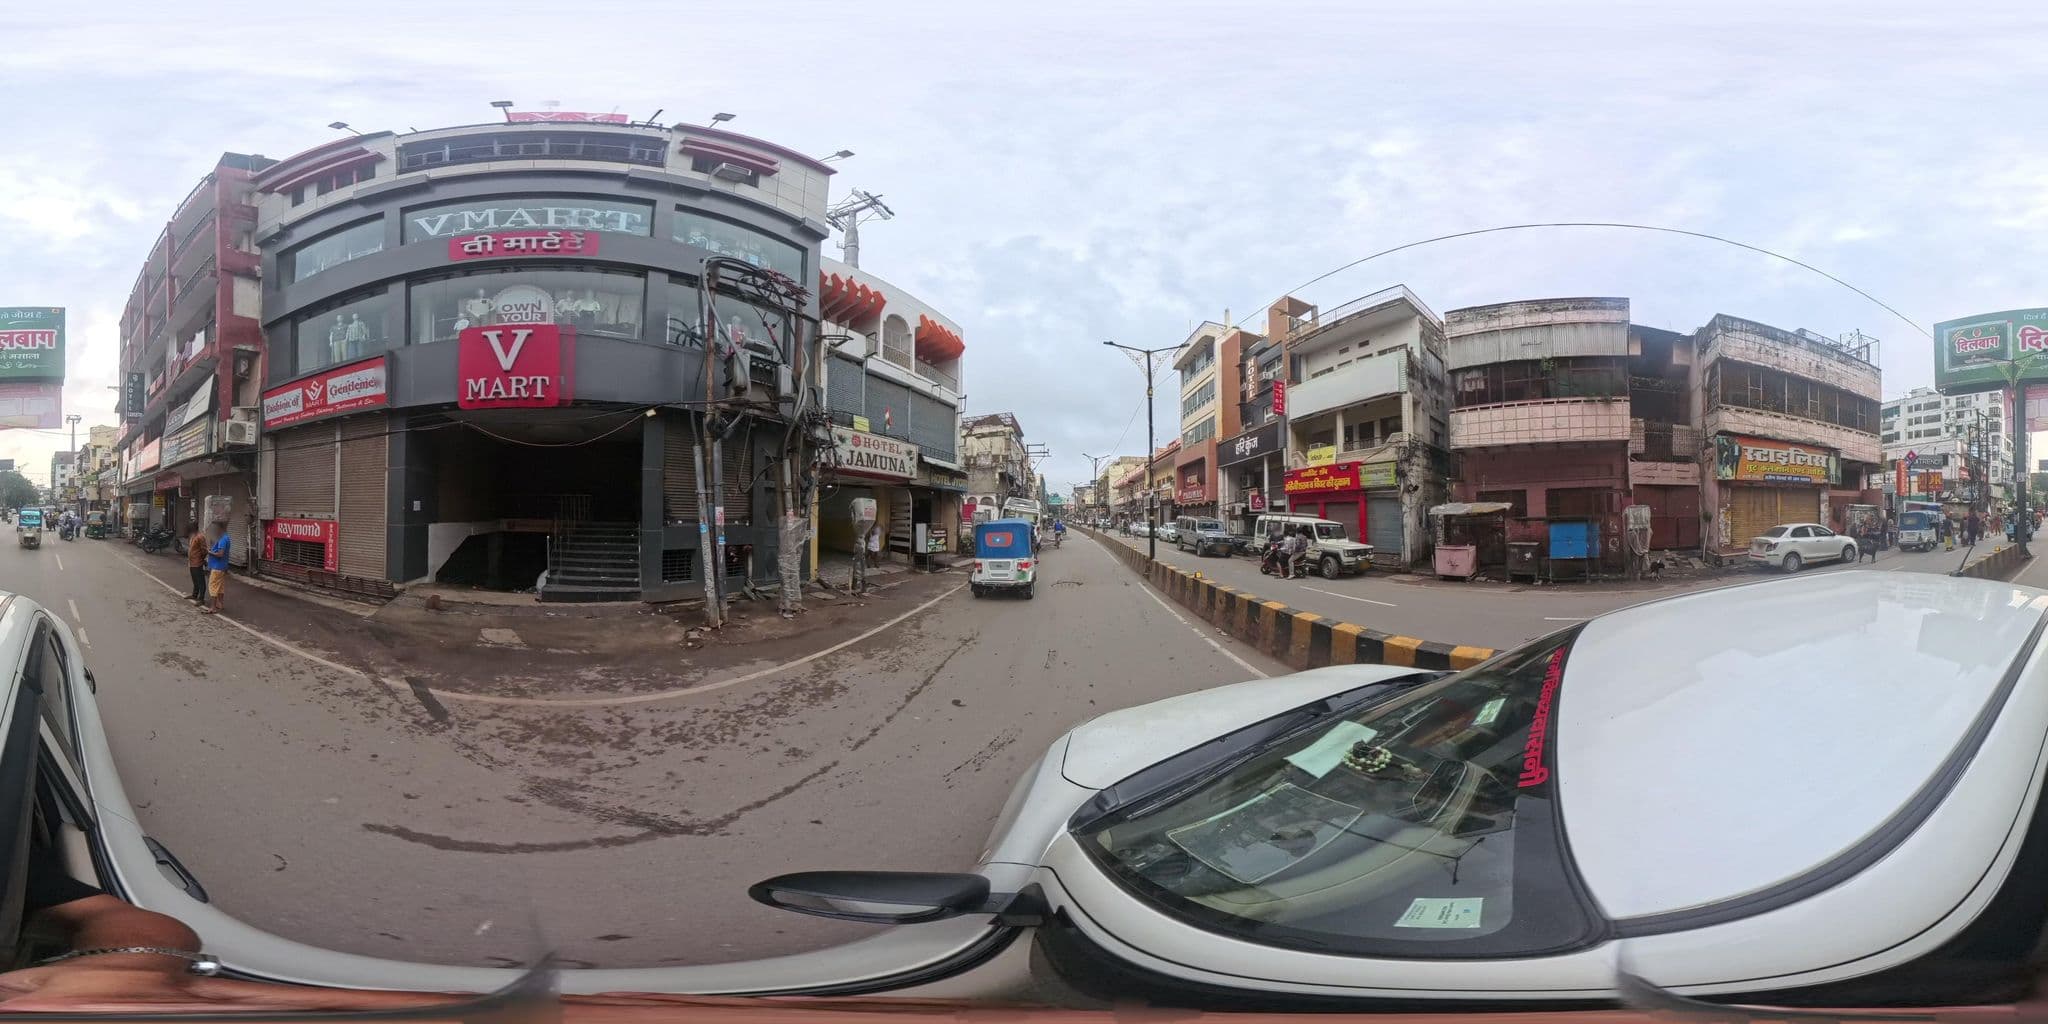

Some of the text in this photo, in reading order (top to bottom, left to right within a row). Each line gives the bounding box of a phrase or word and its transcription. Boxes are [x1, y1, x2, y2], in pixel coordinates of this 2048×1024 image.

[460, 235, 496, 256] वी
[501, 300, 541, 312] OWN
[501, 312, 542, 322] YOUR
[481, 329, 533, 372] V
[465, 376, 550, 400] MART
[863, 437, 901, 455] HOTEL
[846, 449, 907, 474] JAMUNA
[277, 522, 321, 538] Raymond
